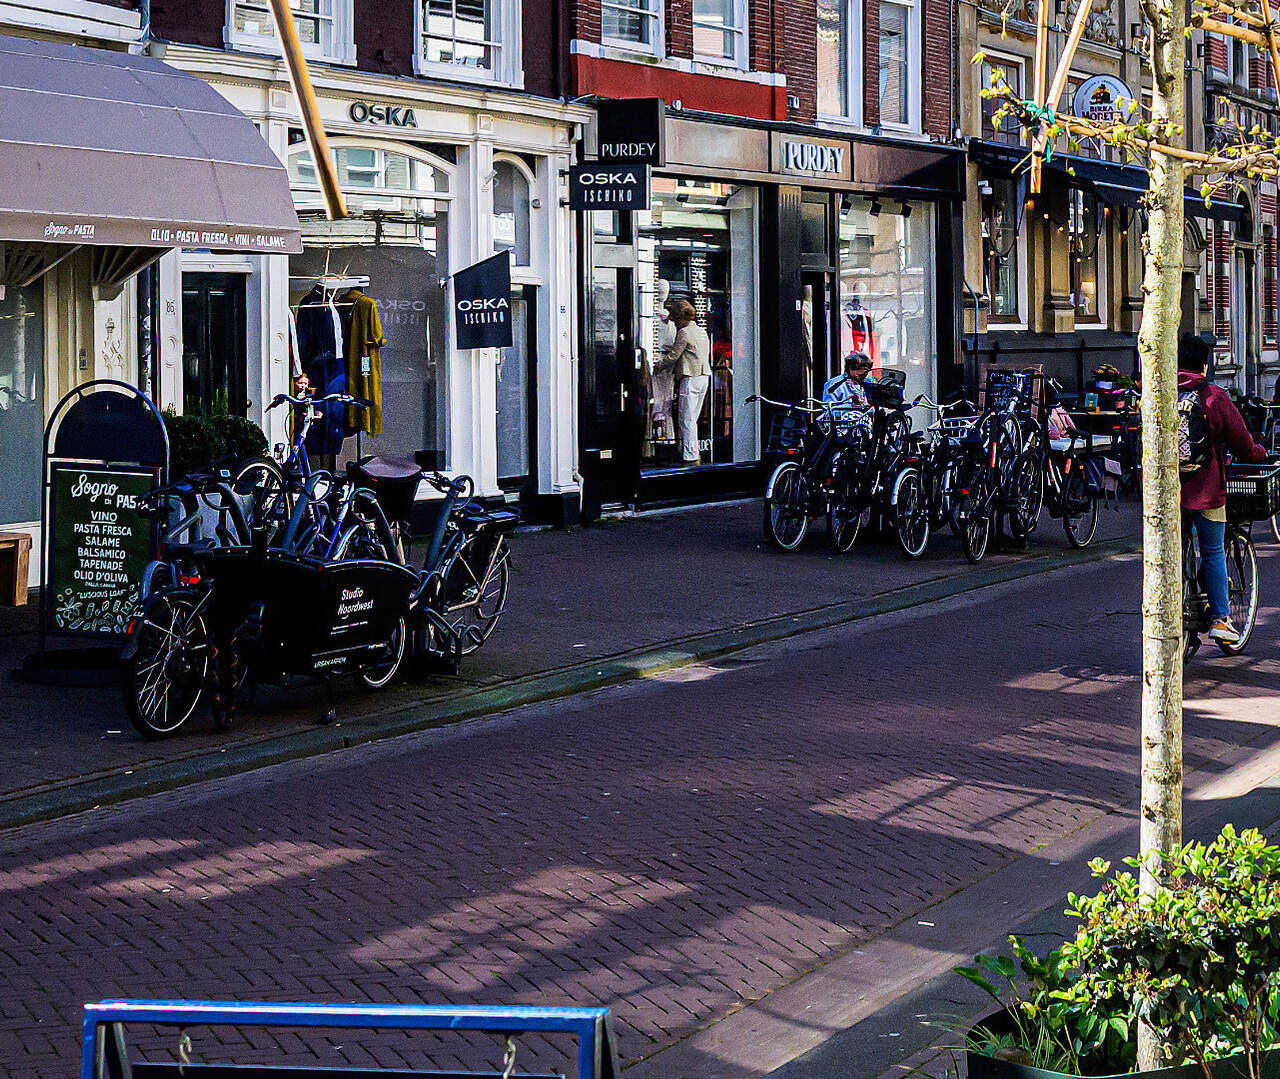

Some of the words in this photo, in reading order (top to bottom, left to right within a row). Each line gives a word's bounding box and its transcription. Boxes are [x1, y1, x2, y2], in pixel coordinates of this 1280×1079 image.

[349, 101, 418, 128] OSKA
[601, 142, 656, 157] PURDEY
[785, 141, 844, 174] PURDEY
[579, 172, 637, 185] OSKA
[584, 189, 632, 203] ISCHIKO
[73, 224, 95, 236] PASTA
[150, 228, 170, 242] OLIO
[176, 230, 199, 244] PASTA
[201, 231, 229, 245] FRESCA
[235, 233, 250, 246] VINI
[256, 235, 286, 248] SALAME
[457, 297, 509, 311] OSKA
[71, 473, 118, 502] Sogno
[116, 494, 147, 509] PAS
[91, 510, 118, 522] VINO
[74, 523, 99, 535] PASTA
[102, 525, 132, 537] FRESCA
[85, 536, 120, 548] SALAME
[77, 547, 126, 560] BALSAMICO
[80, 558, 123, 571] TAPENADE
[74, 570, 94, 581] OLIO
[96, 571, 128, 583] D'OLIVA
[341, 586, 364, 601] Studio
